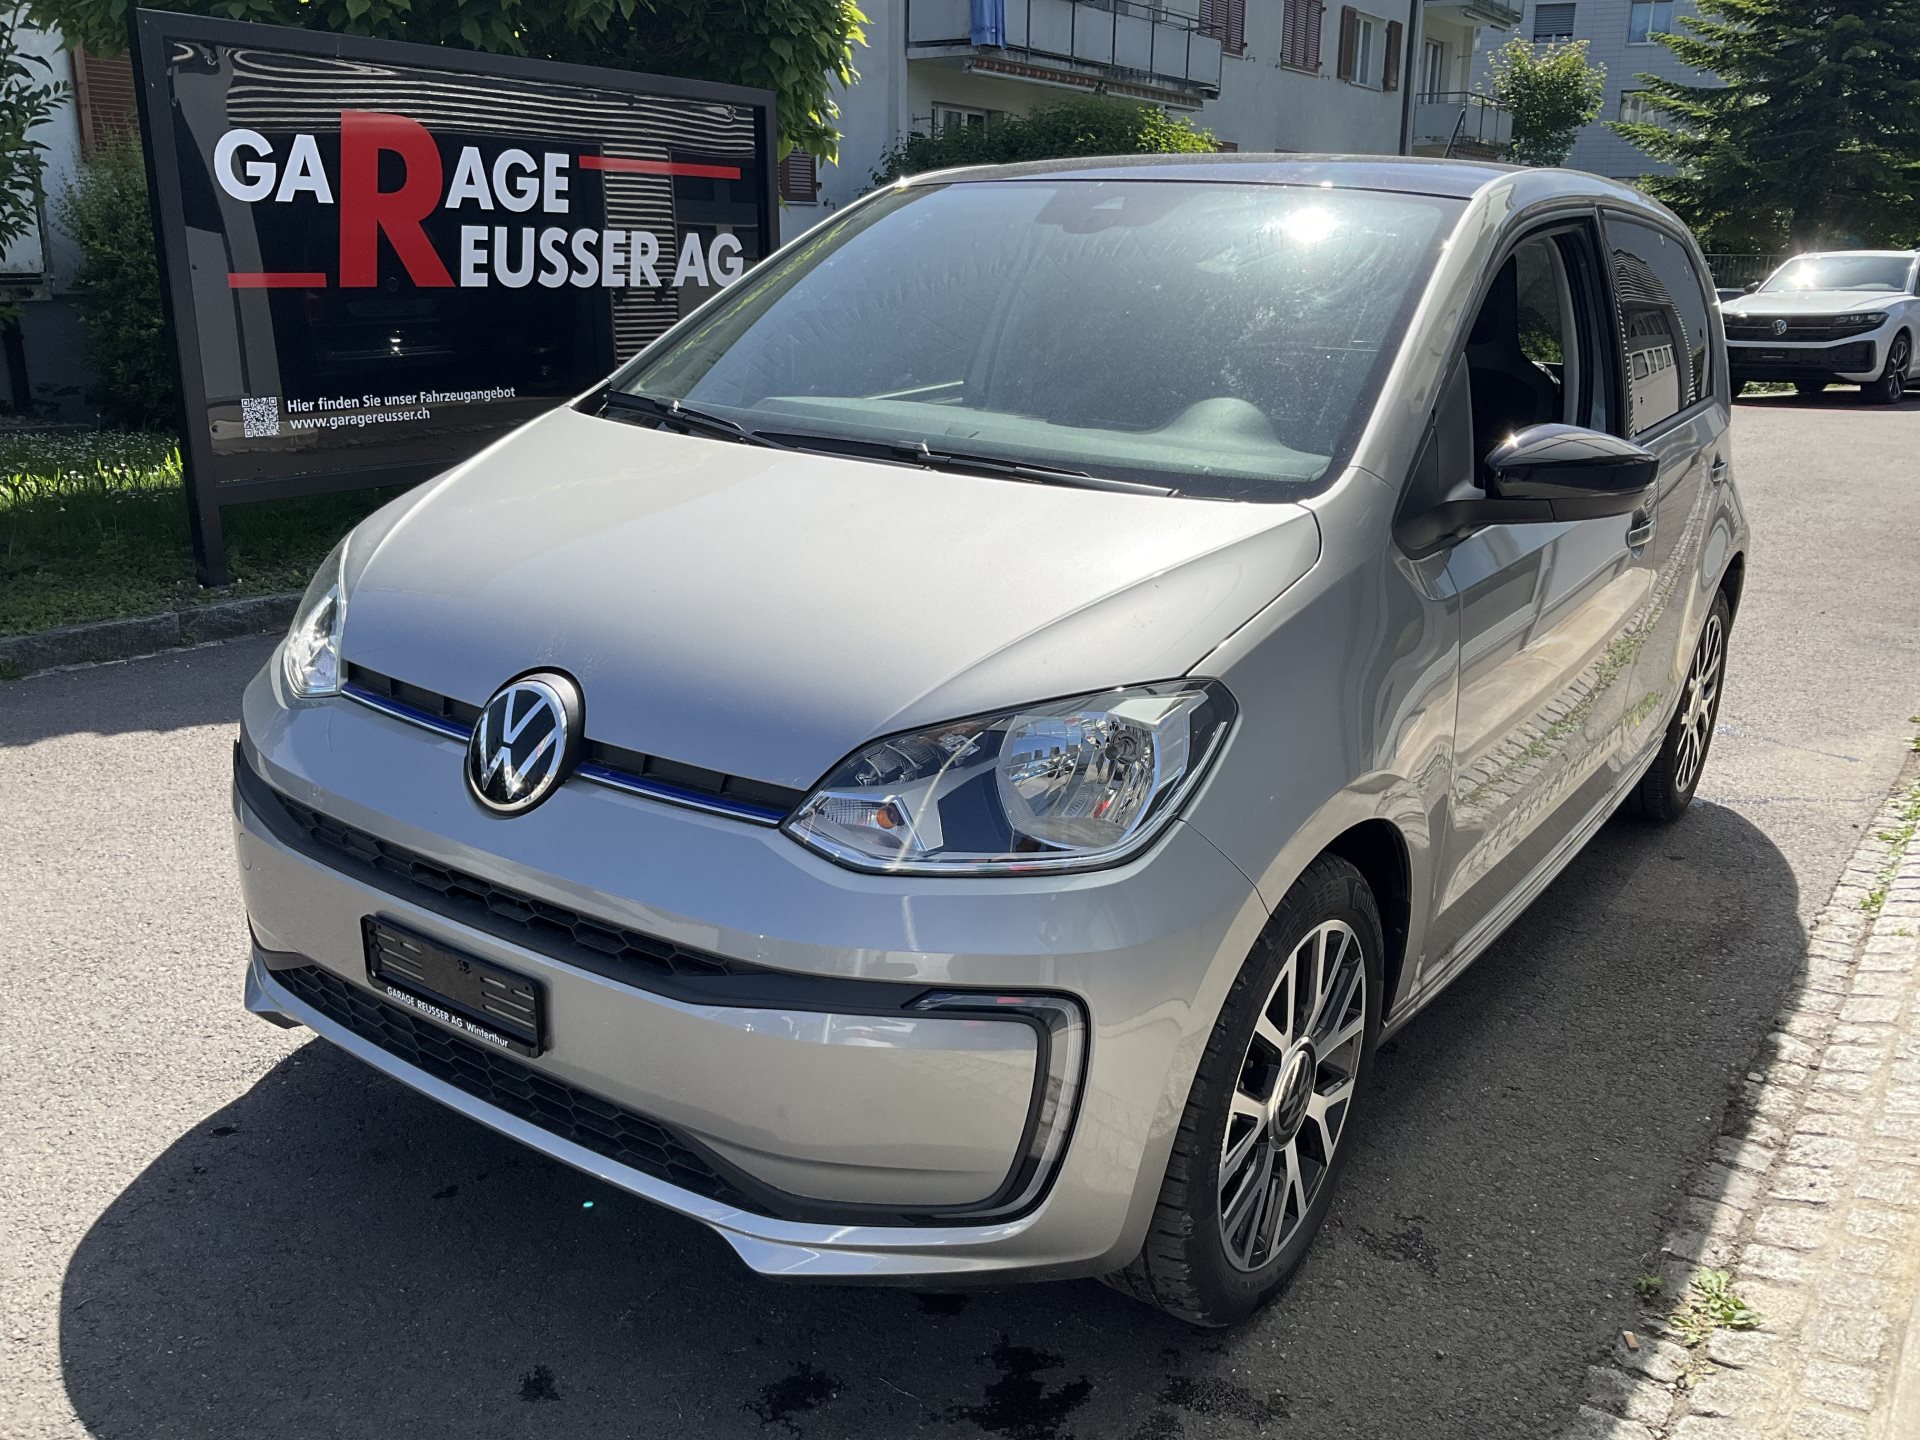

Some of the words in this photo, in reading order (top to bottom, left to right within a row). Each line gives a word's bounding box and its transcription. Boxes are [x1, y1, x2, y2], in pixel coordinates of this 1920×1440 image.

[214, 111, 570, 287] GARAGE
[671, 232, 744, 287] AG
[287, 399, 315, 413] Hier
[318, 396, 360, 411] finden
[362, 394, 382, 407] Sie
[384, 394, 417, 406] unser
[420, 386, 516, 403] Fahrzeugangebot
[290, 407, 431, 430] www.garagereusser.ch
[472, 682, 565, 806] VW
[387, 986, 415, 1006] GARAGE
[417, 1000, 450, 1022] REUSSER
[451, 1015, 463, 1027] AG
[466, 1022, 509, 1047] Winterthur
